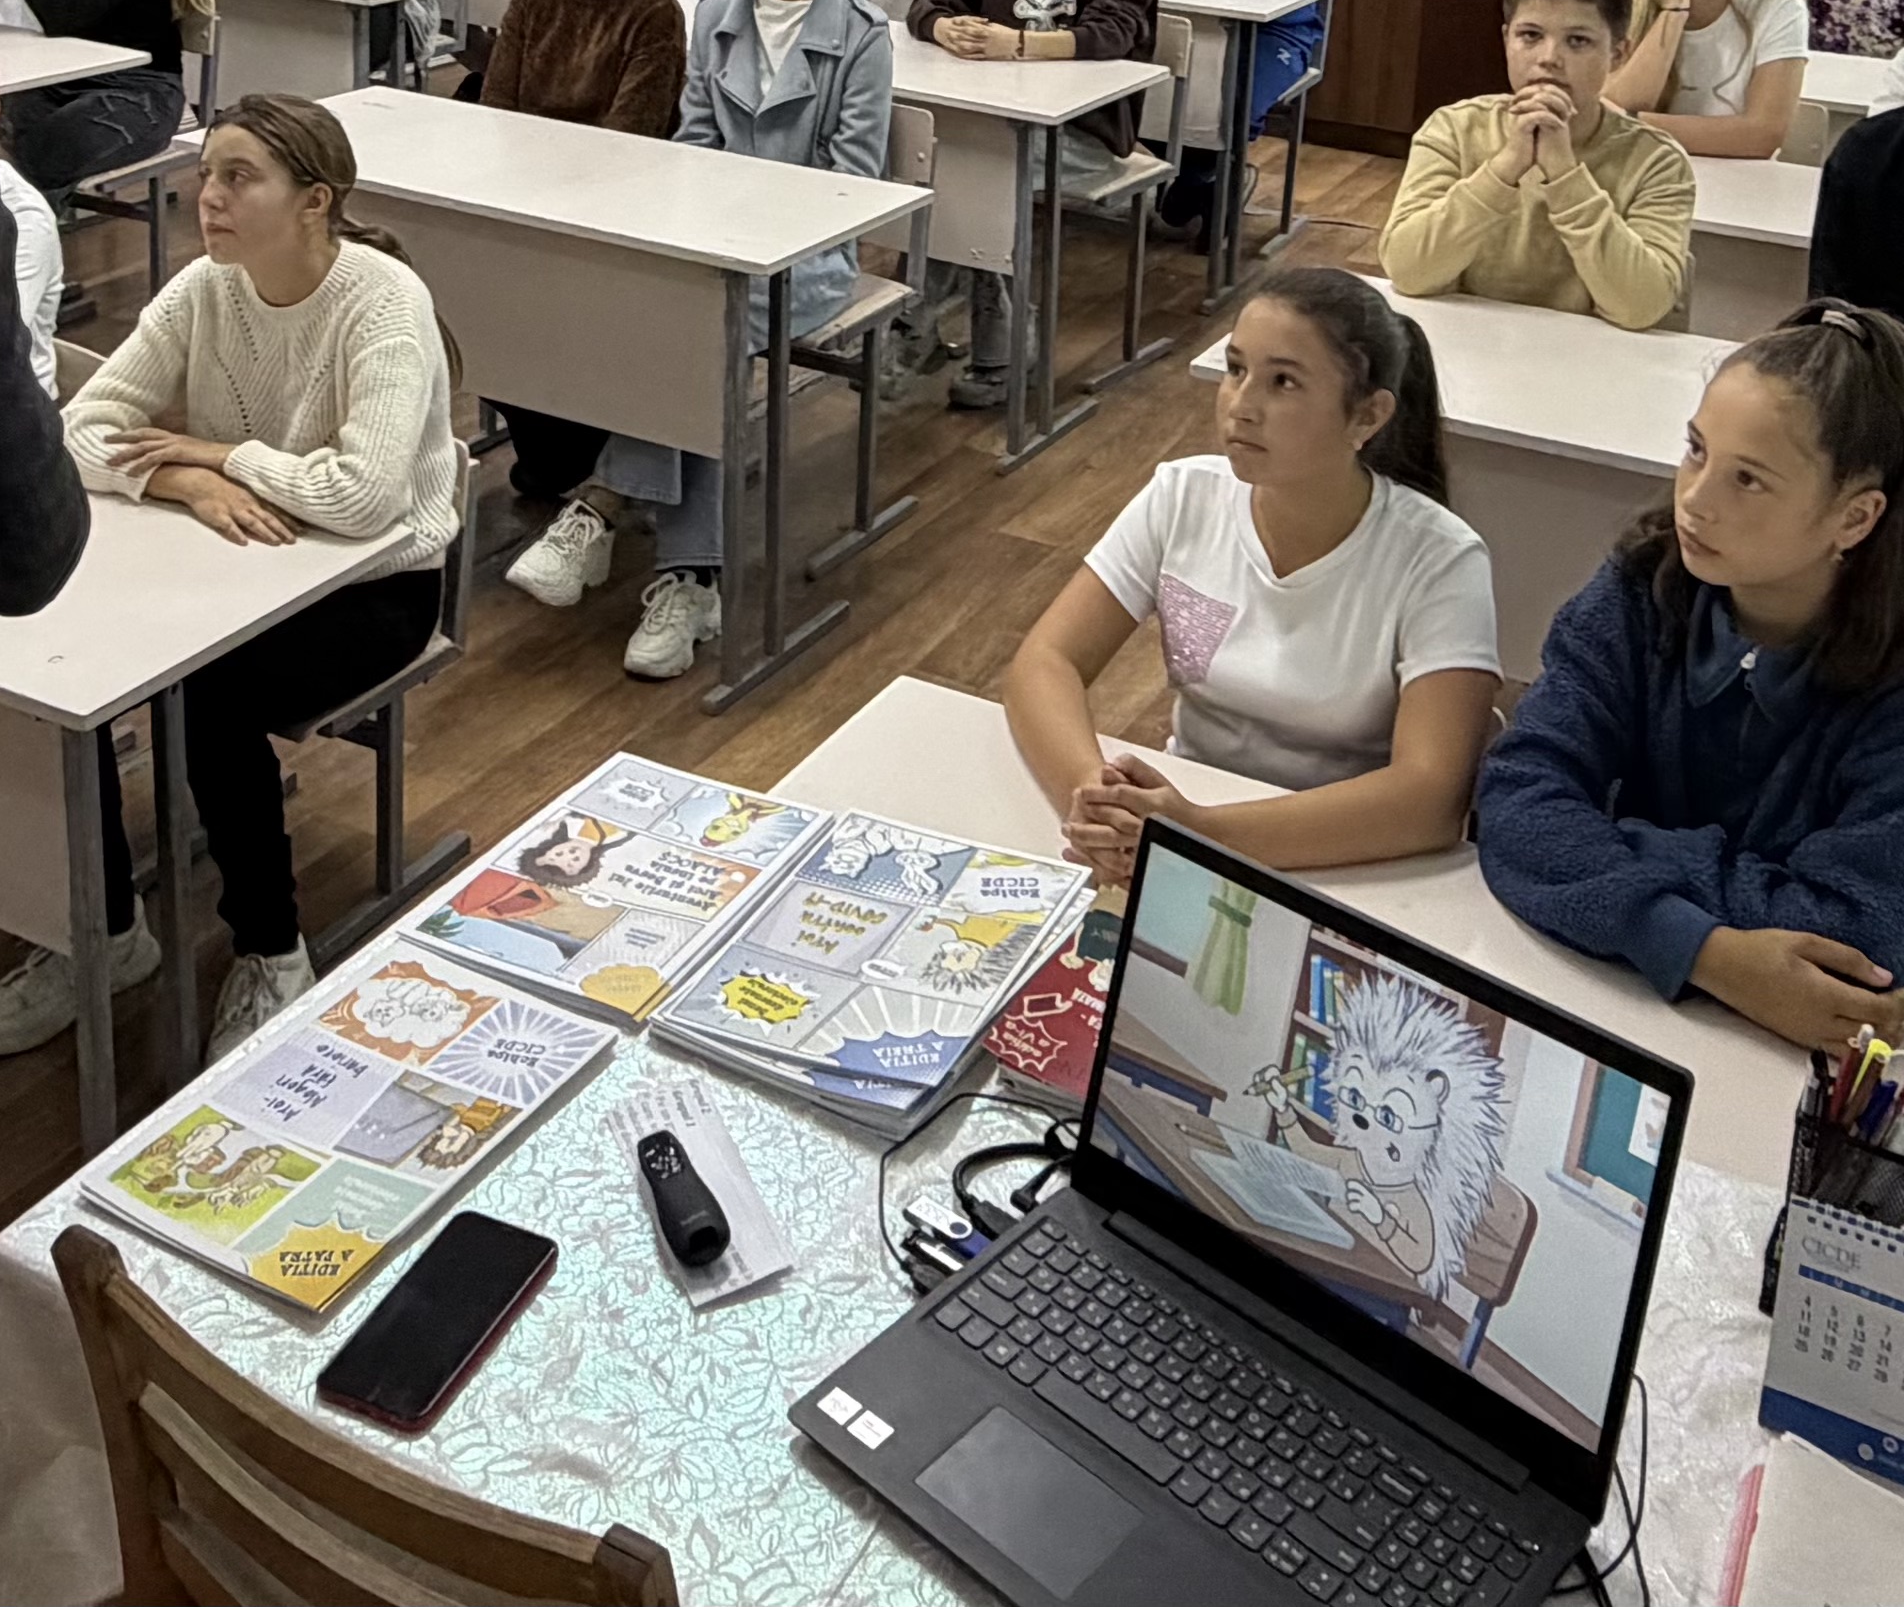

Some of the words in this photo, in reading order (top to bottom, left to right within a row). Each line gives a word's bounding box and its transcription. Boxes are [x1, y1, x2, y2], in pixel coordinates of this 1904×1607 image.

[981, 877, 1039, 888] CICDE
[980, 888, 1040, 899] Echipa
[494, 1039, 546, 1055] CICDE
[932, 1041, 944, 1051] A
[487, 1050, 540, 1068] Echipa
[342, 1249, 355, 1262] A
[1805, 1295, 1812, 1307] 4
[1801, 1309, 1812, 1323] 11
